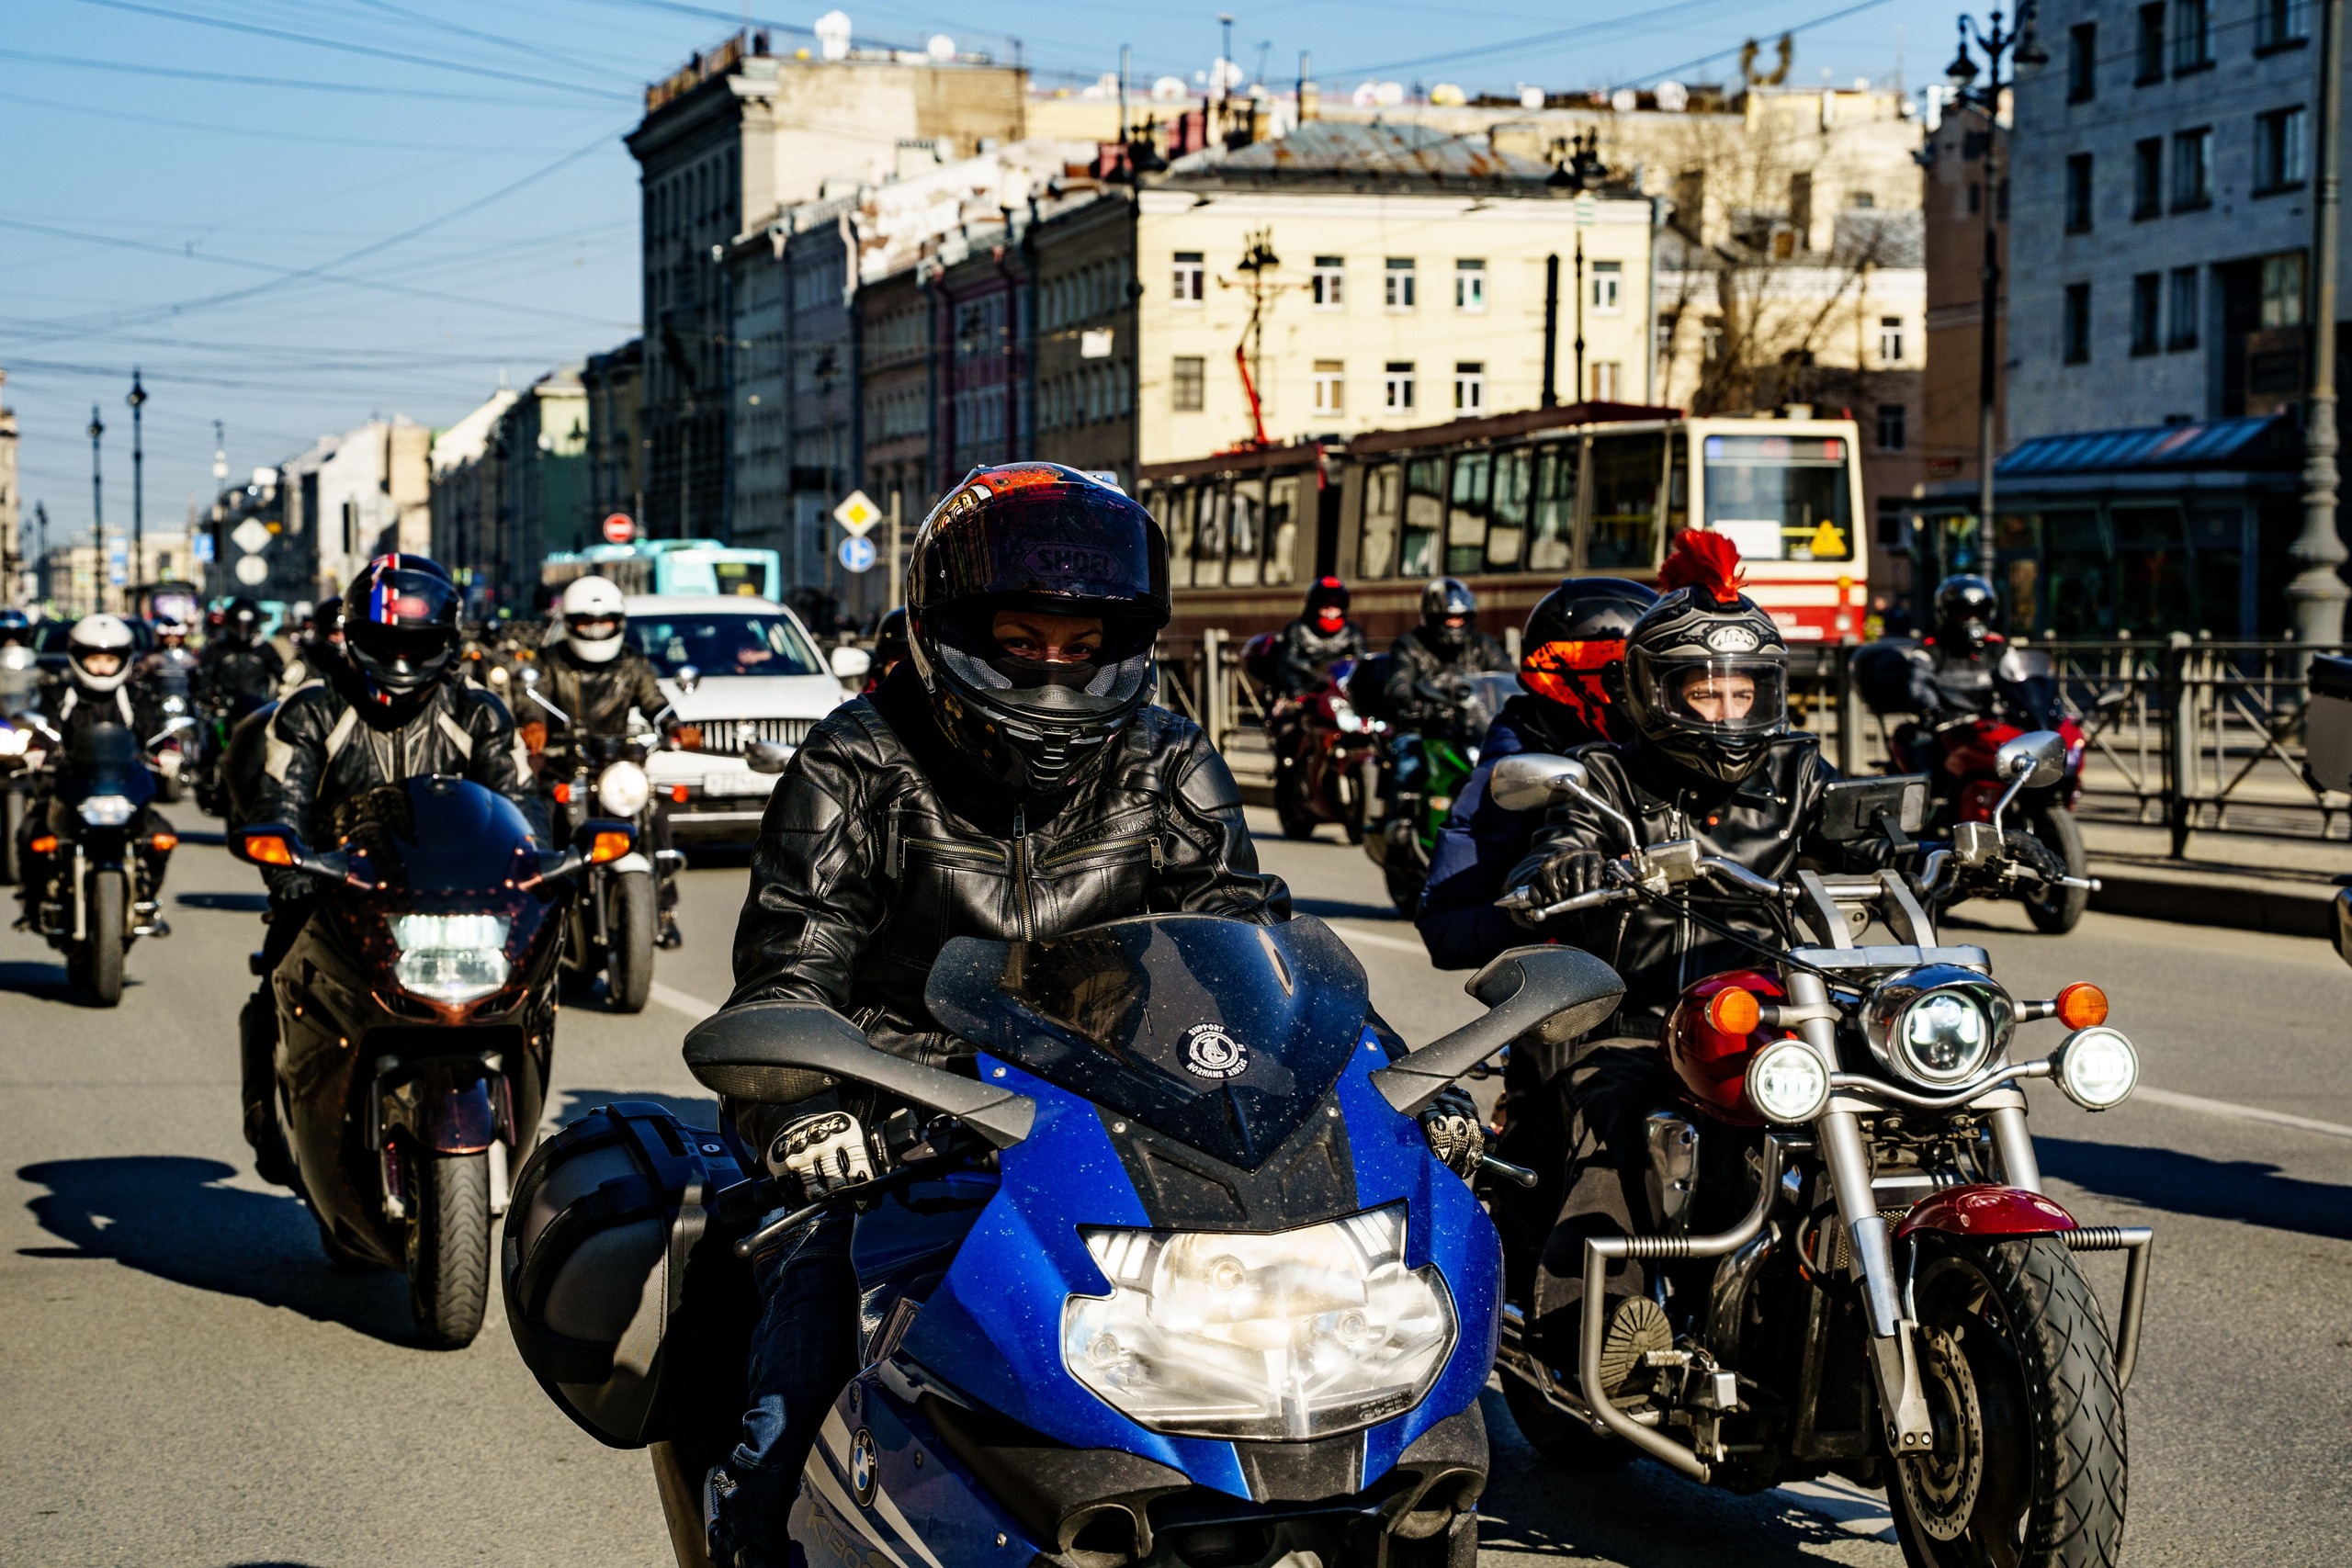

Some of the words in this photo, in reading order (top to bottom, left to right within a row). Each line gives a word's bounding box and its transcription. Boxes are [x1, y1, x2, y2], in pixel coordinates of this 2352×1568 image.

[1037, 549, 1110, 577] SHOEI
[1188, 1023, 1225, 1036] SUPPORT
[1186, 1062, 1224, 1078] NORMANS
[1226, 1058, 1248, 1077] RIDERS
[778, 1117, 841, 1153] DAINESE
[854, 1434, 876, 1466] BMW
[806, 1501, 872, 1568] K130
